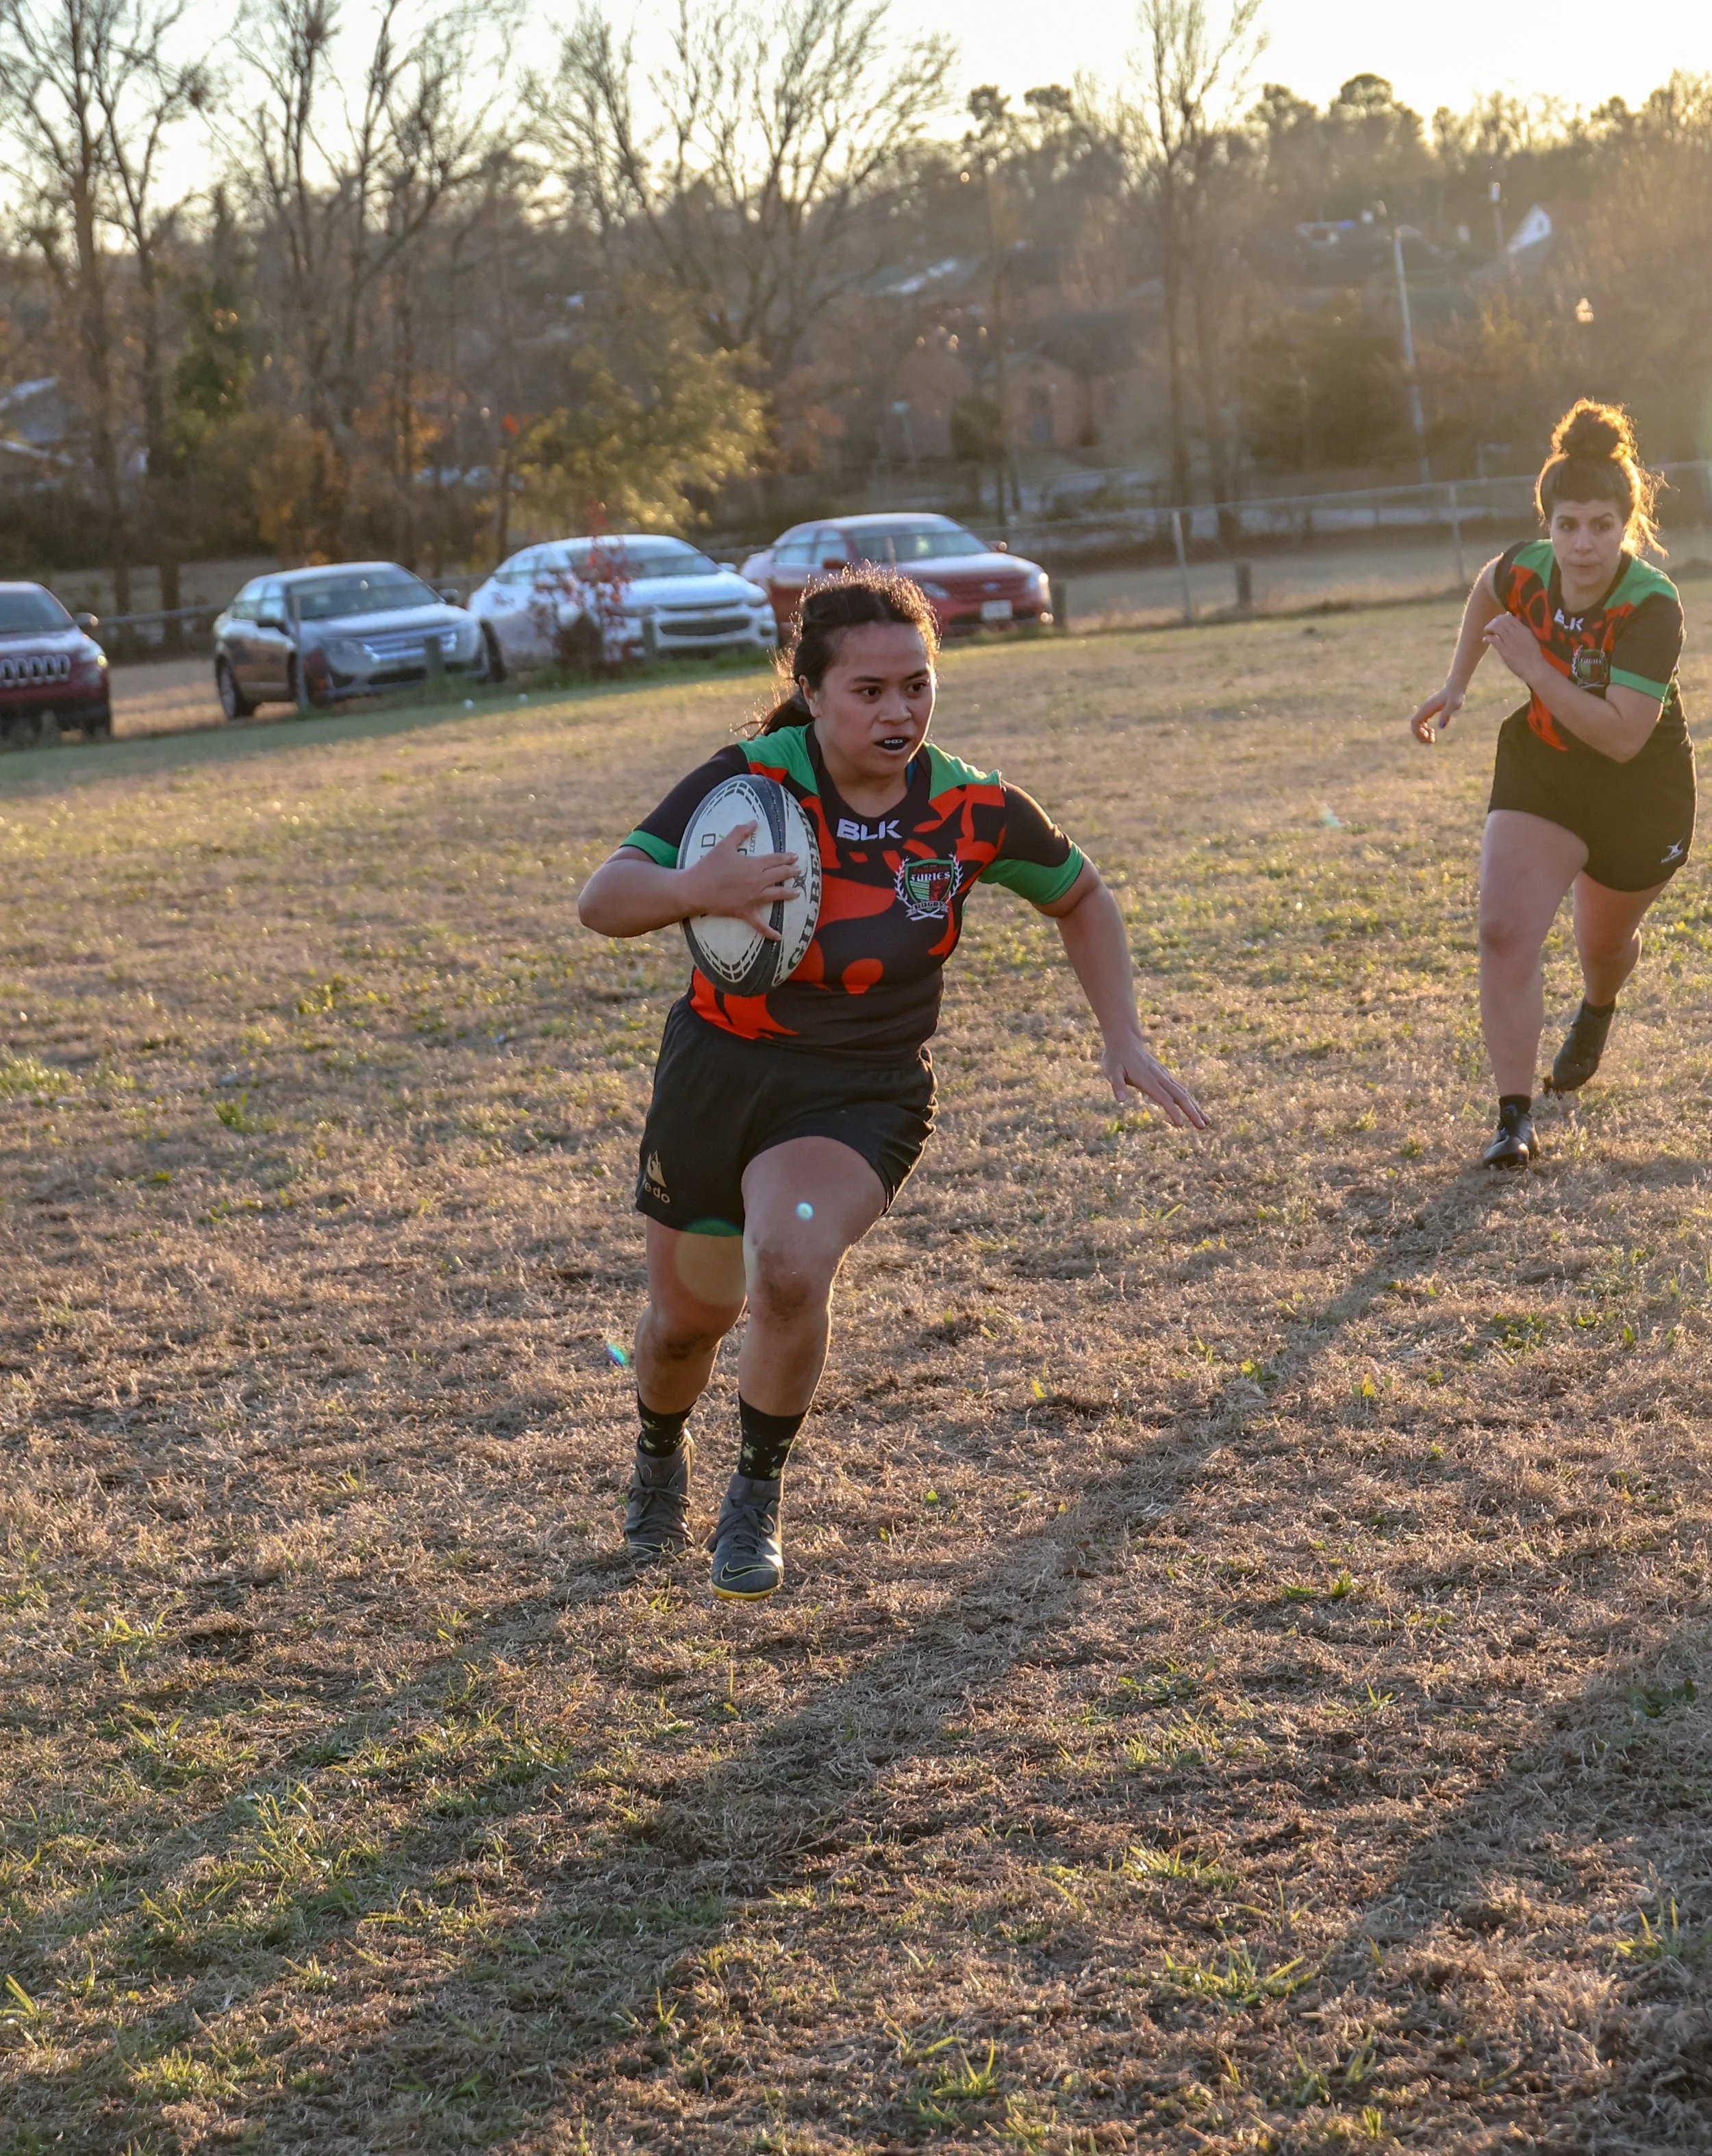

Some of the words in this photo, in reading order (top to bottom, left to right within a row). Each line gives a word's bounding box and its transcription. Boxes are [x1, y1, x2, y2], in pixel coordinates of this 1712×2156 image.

[836, 818, 903, 841] BLK
[788, 803, 820, 970] GILBERT
[909, 871, 951, 882] FURIES
[643, 1177, 670, 1203] edo
